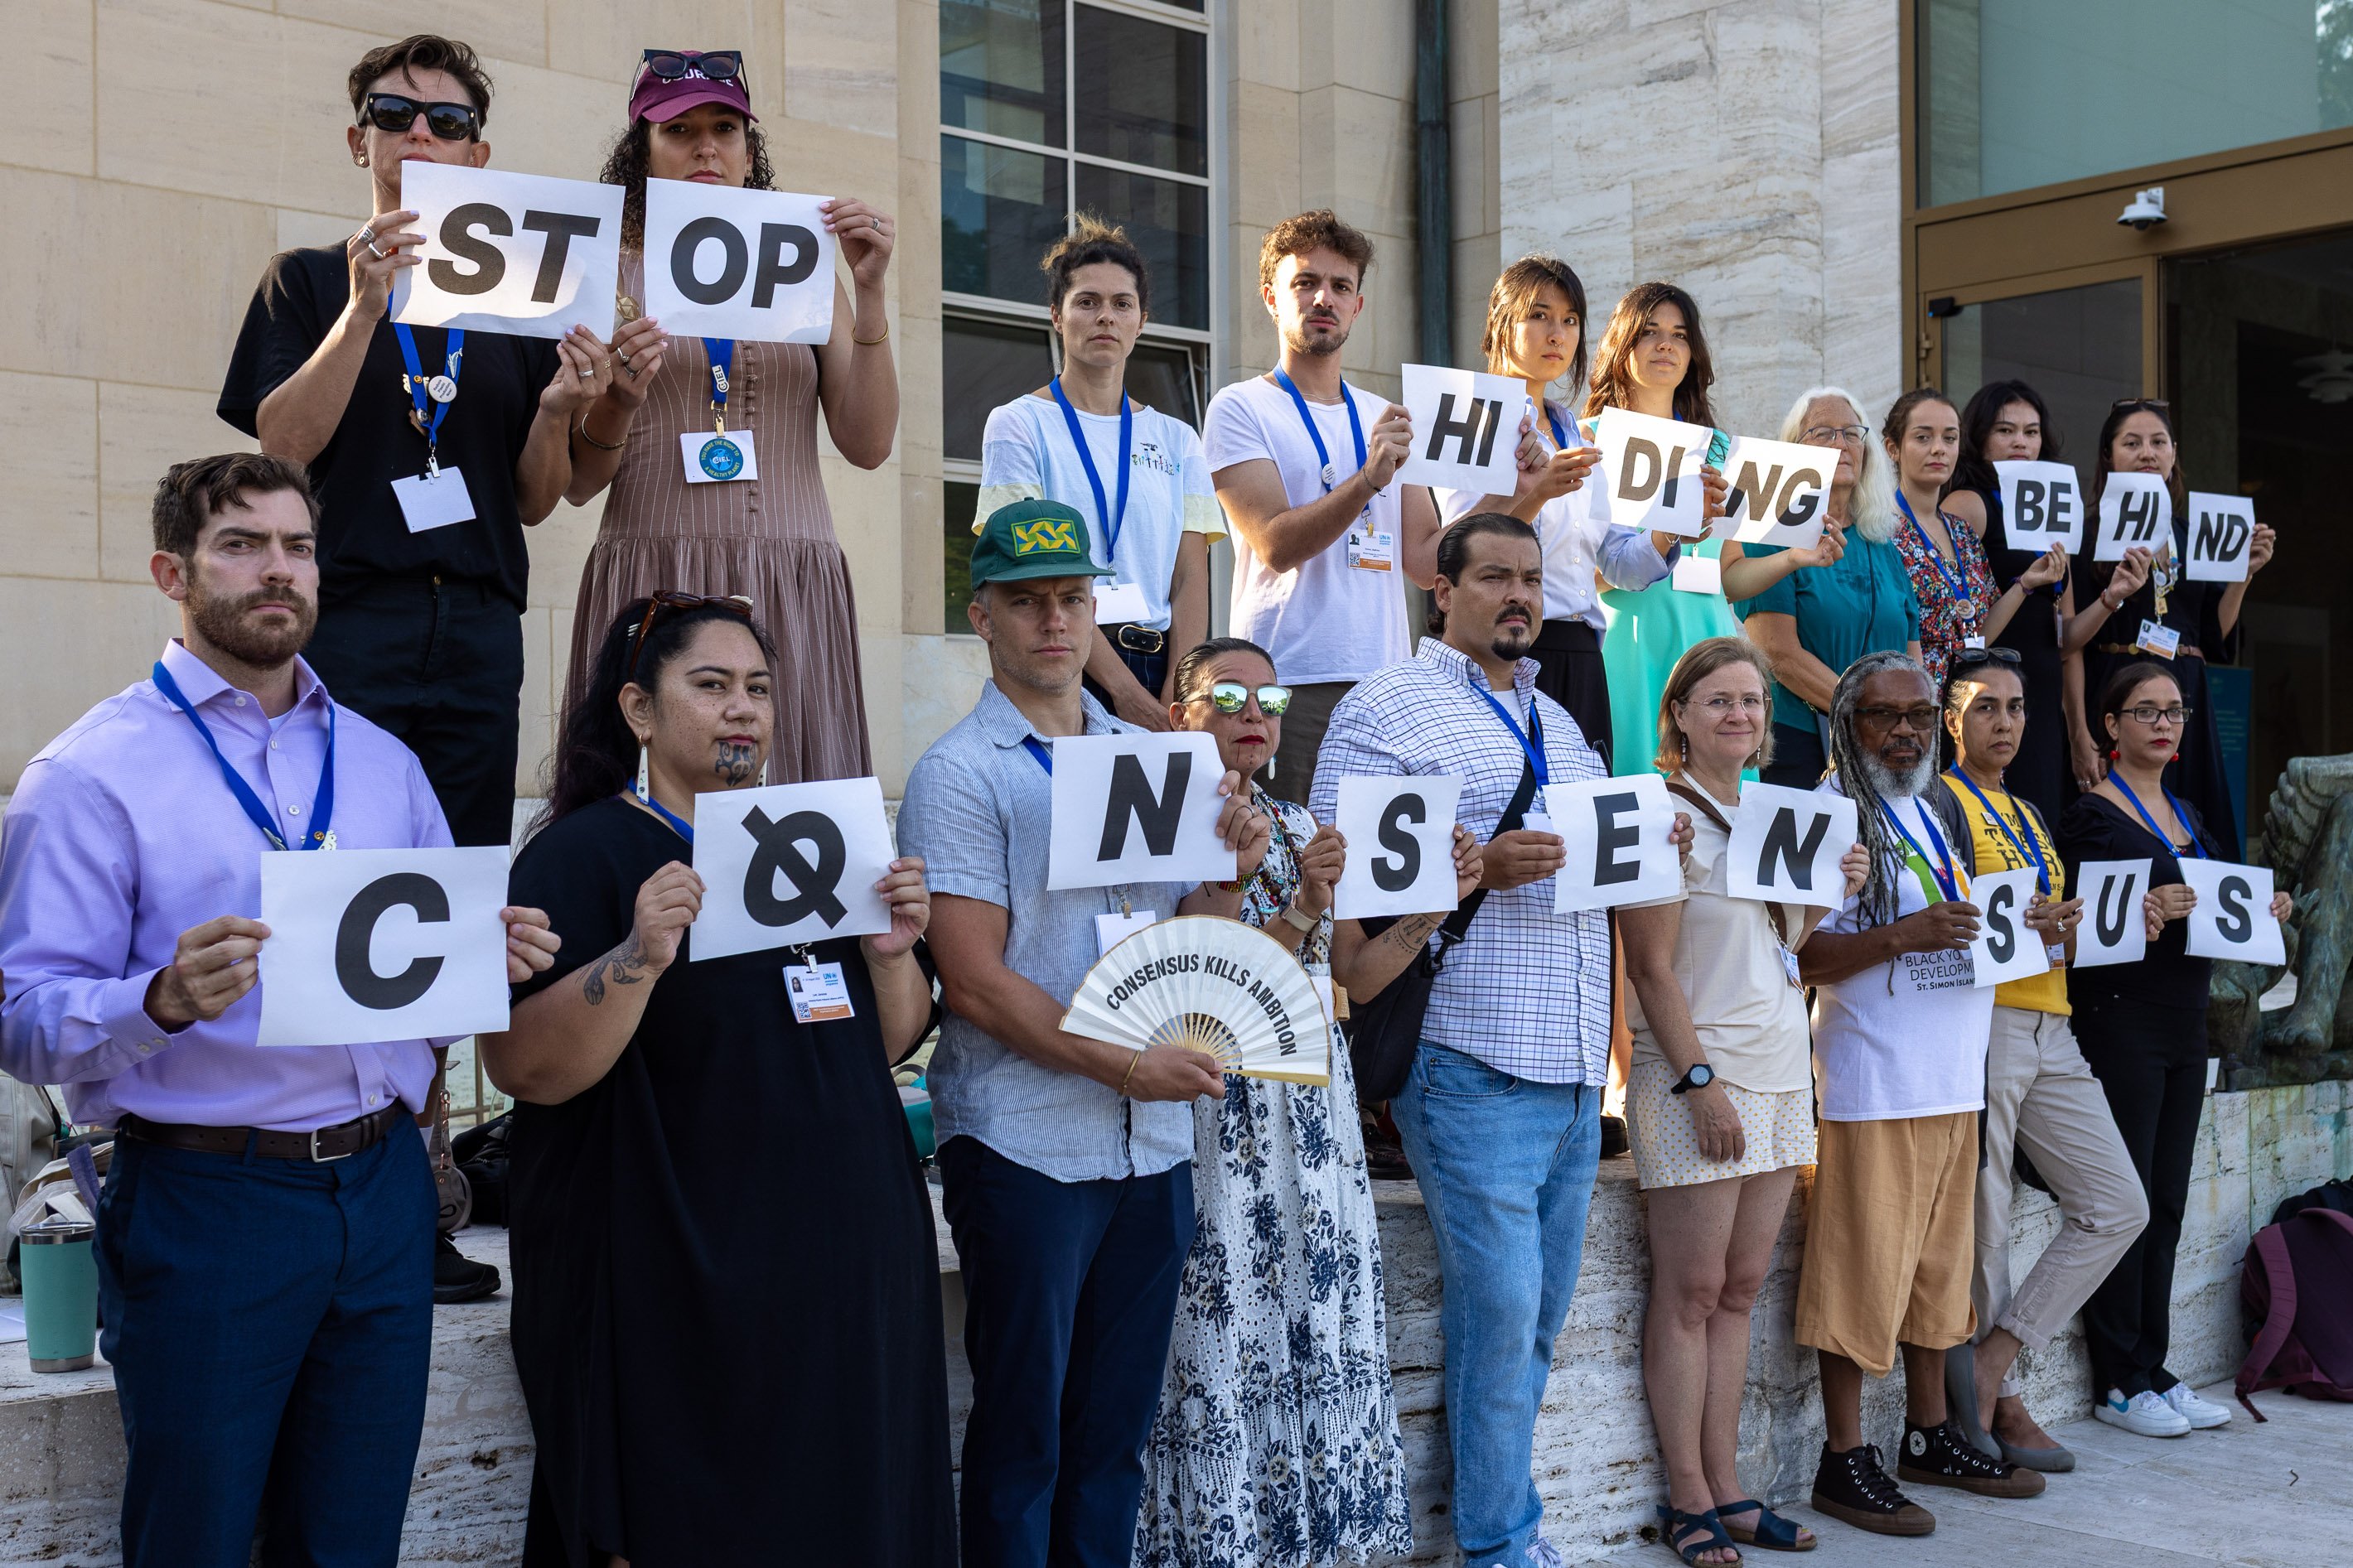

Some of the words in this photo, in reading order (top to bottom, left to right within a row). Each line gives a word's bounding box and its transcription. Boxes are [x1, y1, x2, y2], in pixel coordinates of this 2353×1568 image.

[428, 202, 602, 304] ST
[670, 216, 819, 309] OP
[714, 366, 729, 392] CIEL
[704, 441, 715, 452] HAVE
[722, 441, 736, 451] RIGHT
[712, 456, 731, 464] CIEL
[1425, 393, 1503, 468] HI
[708, 469, 728, 478] HEALTHY
[727, 461, 740, 475] PLANET
[1617, 436, 1684, 509] DI
[1724, 460, 1822, 528] NG
[2014, 479, 2072, 533] BE
[2112, 490, 2160, 542] HI
[2193, 511, 2249, 562] ND
[1096, 751, 1193, 862] N
[1592, 791, 1641, 887] E
[1370, 793, 1427, 892] S
[1756, 806, 1833, 891] N
[335, 872, 451, 1011] C
[1986, 884, 2016, 964] S
[2095, 873, 2137, 948] U
[2215, 875, 2253, 943] S
[1905, 951, 1945, 967] BLACK
[1910, 961, 1975, 981] DEVELOPM
[1929, 980, 1954, 990] SIMON
[1106, 953, 1200, 1011] CONSENSUS
[1204, 955, 1252, 987] KILLS
[1246, 979, 1297, 1057] AMBITION
